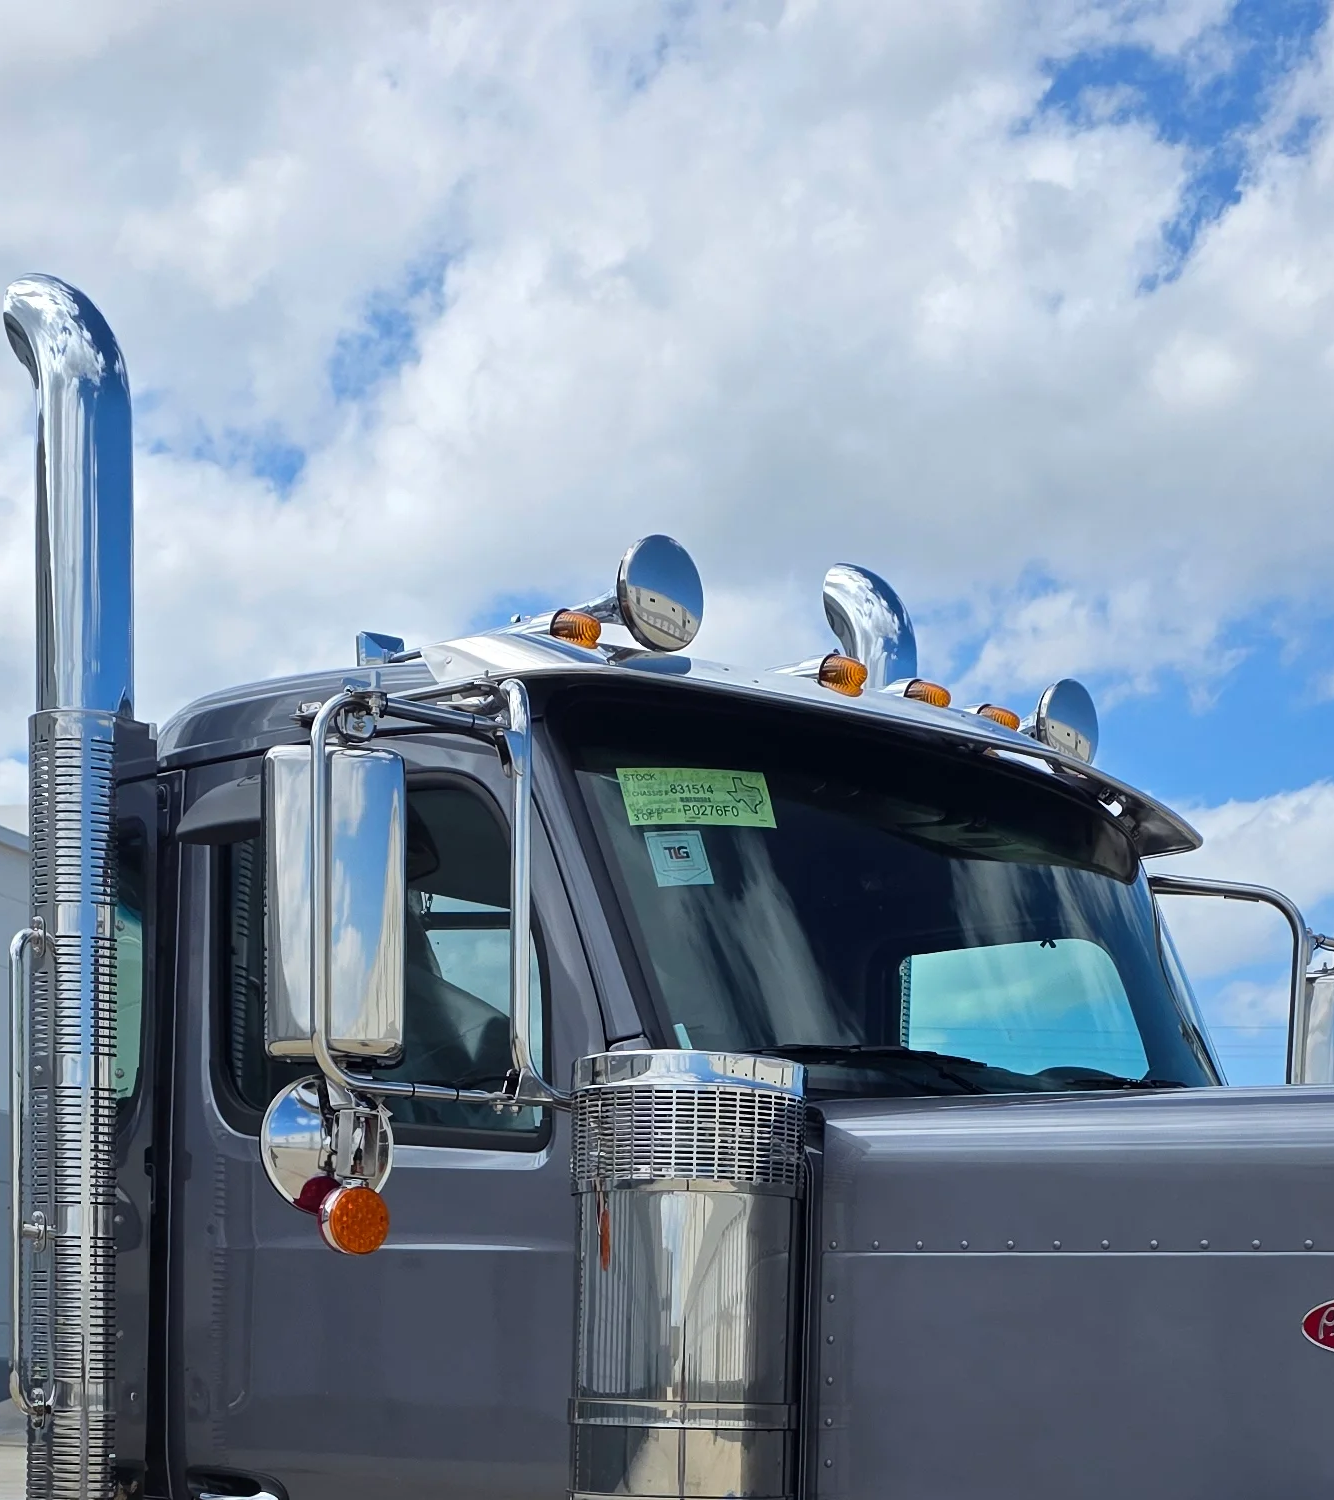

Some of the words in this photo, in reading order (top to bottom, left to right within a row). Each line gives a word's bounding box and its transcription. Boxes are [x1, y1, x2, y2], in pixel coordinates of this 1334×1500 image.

[623, 773, 657, 782] STOCK
[669, 783, 714, 795] 831514
[682, 804, 740, 817] P0276F0
[663, 845, 691, 860] TLG
